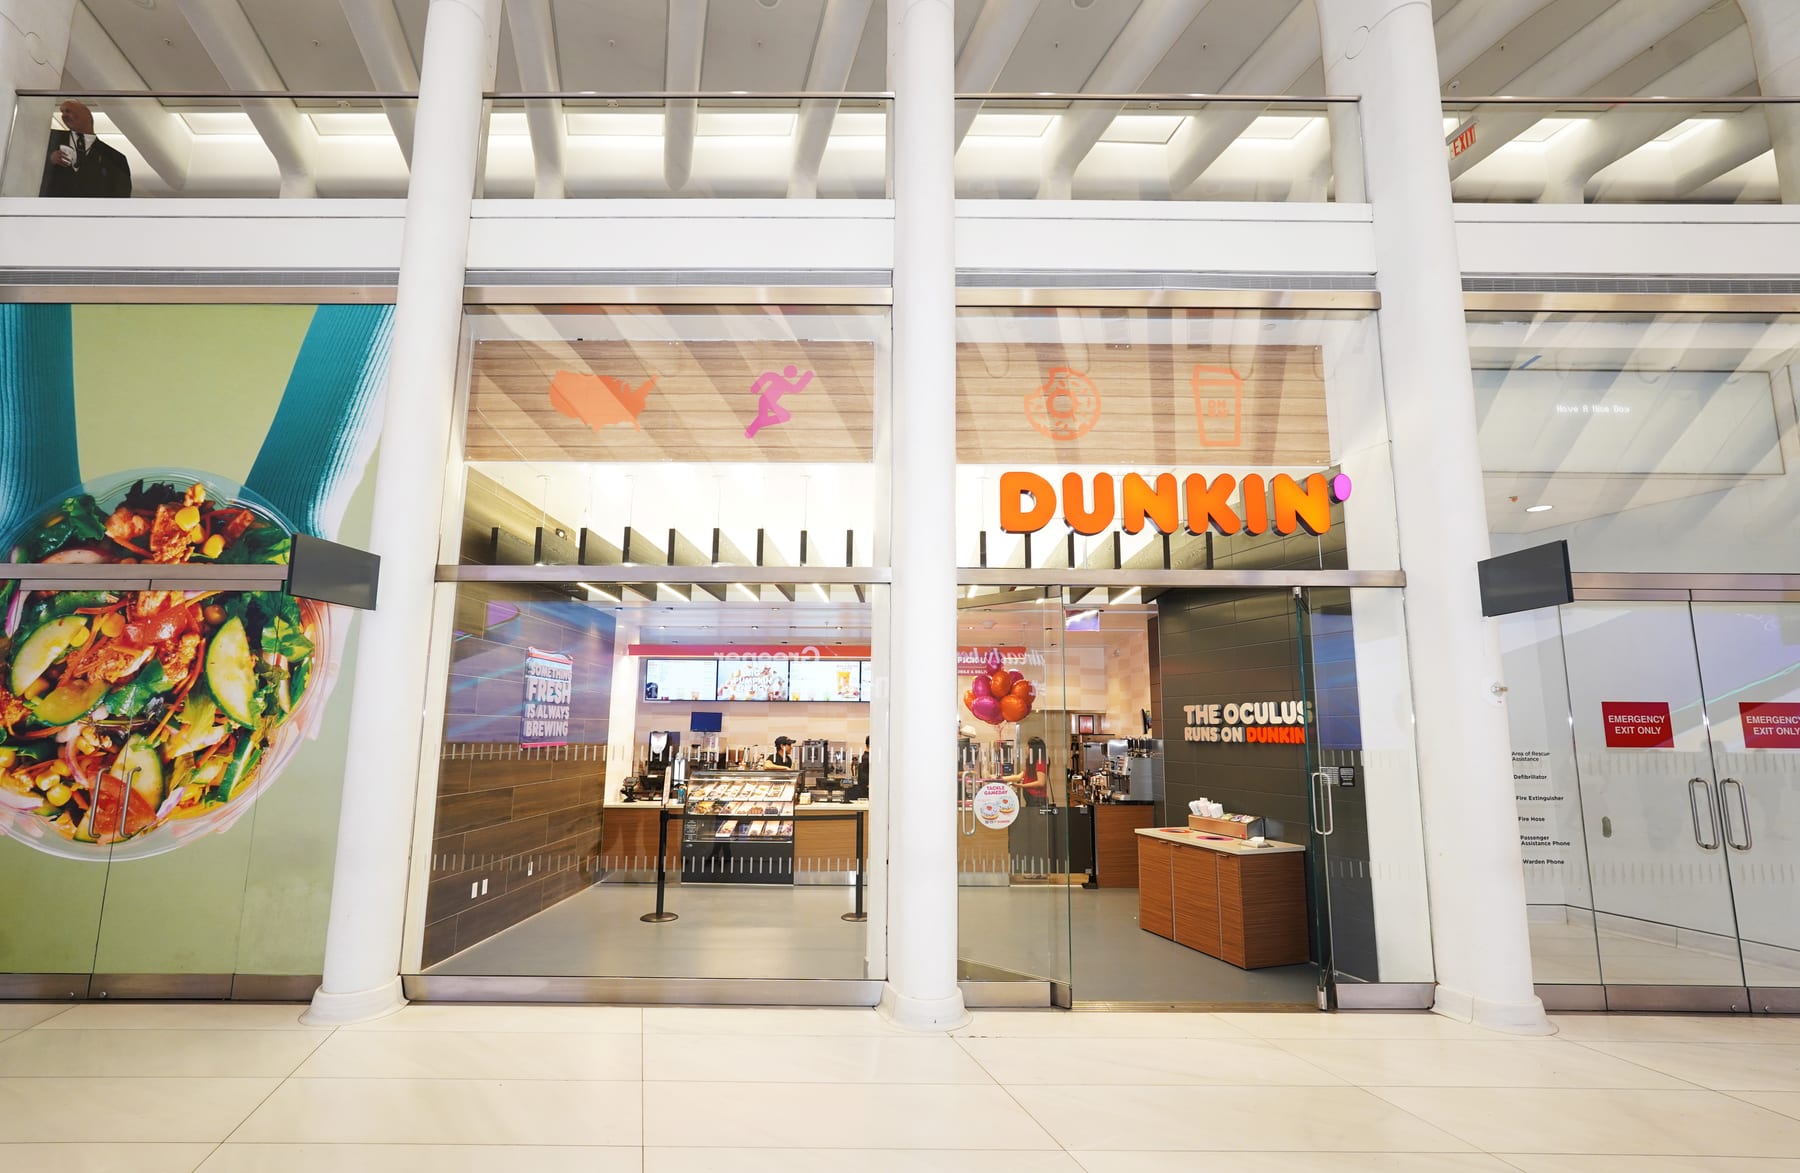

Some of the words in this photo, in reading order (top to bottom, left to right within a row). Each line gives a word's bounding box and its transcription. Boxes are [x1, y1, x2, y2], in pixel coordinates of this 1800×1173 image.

[1453, 124, 1476, 157] EXIT
[1000, 471, 1352, 536] DUNKIN'
[528, 663, 573, 681] SOMETHING
[526, 679, 571, 704] FRESH
[525, 703, 536, 719] IS
[536, 704, 570, 720] ALWAYS
[1183, 704, 1221, 725] THE
[1223, 700, 1313, 725] OCULUS
[1608, 714, 1666, 724] EMERGENCY
[524, 720, 569, 737] BREWING
[1184, 726, 1219, 742] RUNS
[1220, 726, 1245, 743] ON
[1615, 726, 1635, 735] EXIT
[1637, 726, 1662, 735] ONLY
[1753, 727, 1774, 736] EXIT
[1776, 727, 1800, 736] ONLY
